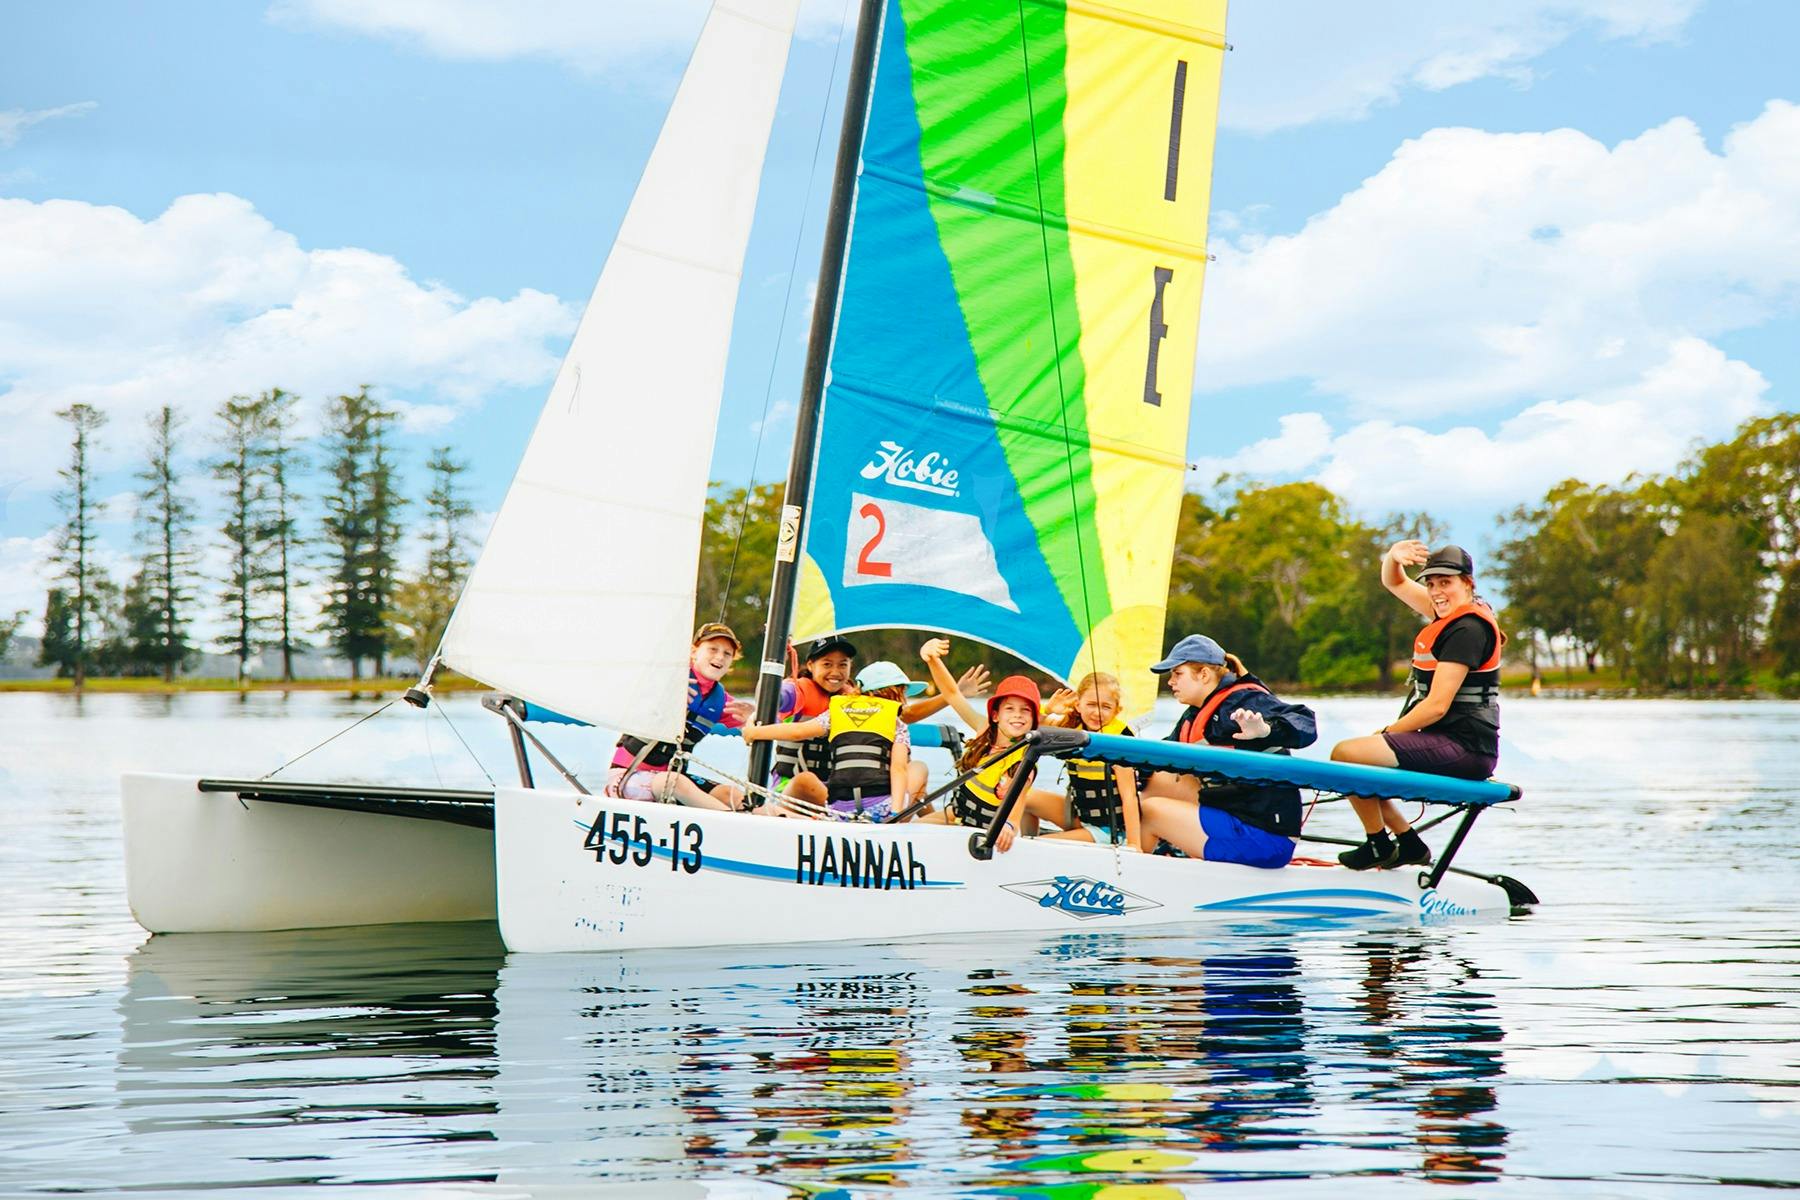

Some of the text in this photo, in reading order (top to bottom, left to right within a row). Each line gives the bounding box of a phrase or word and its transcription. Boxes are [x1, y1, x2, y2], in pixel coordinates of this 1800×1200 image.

[860, 441, 960, 497] Hobie
[857, 503, 892, 577] 2
[1038, 876, 1126, 915] Hobie
